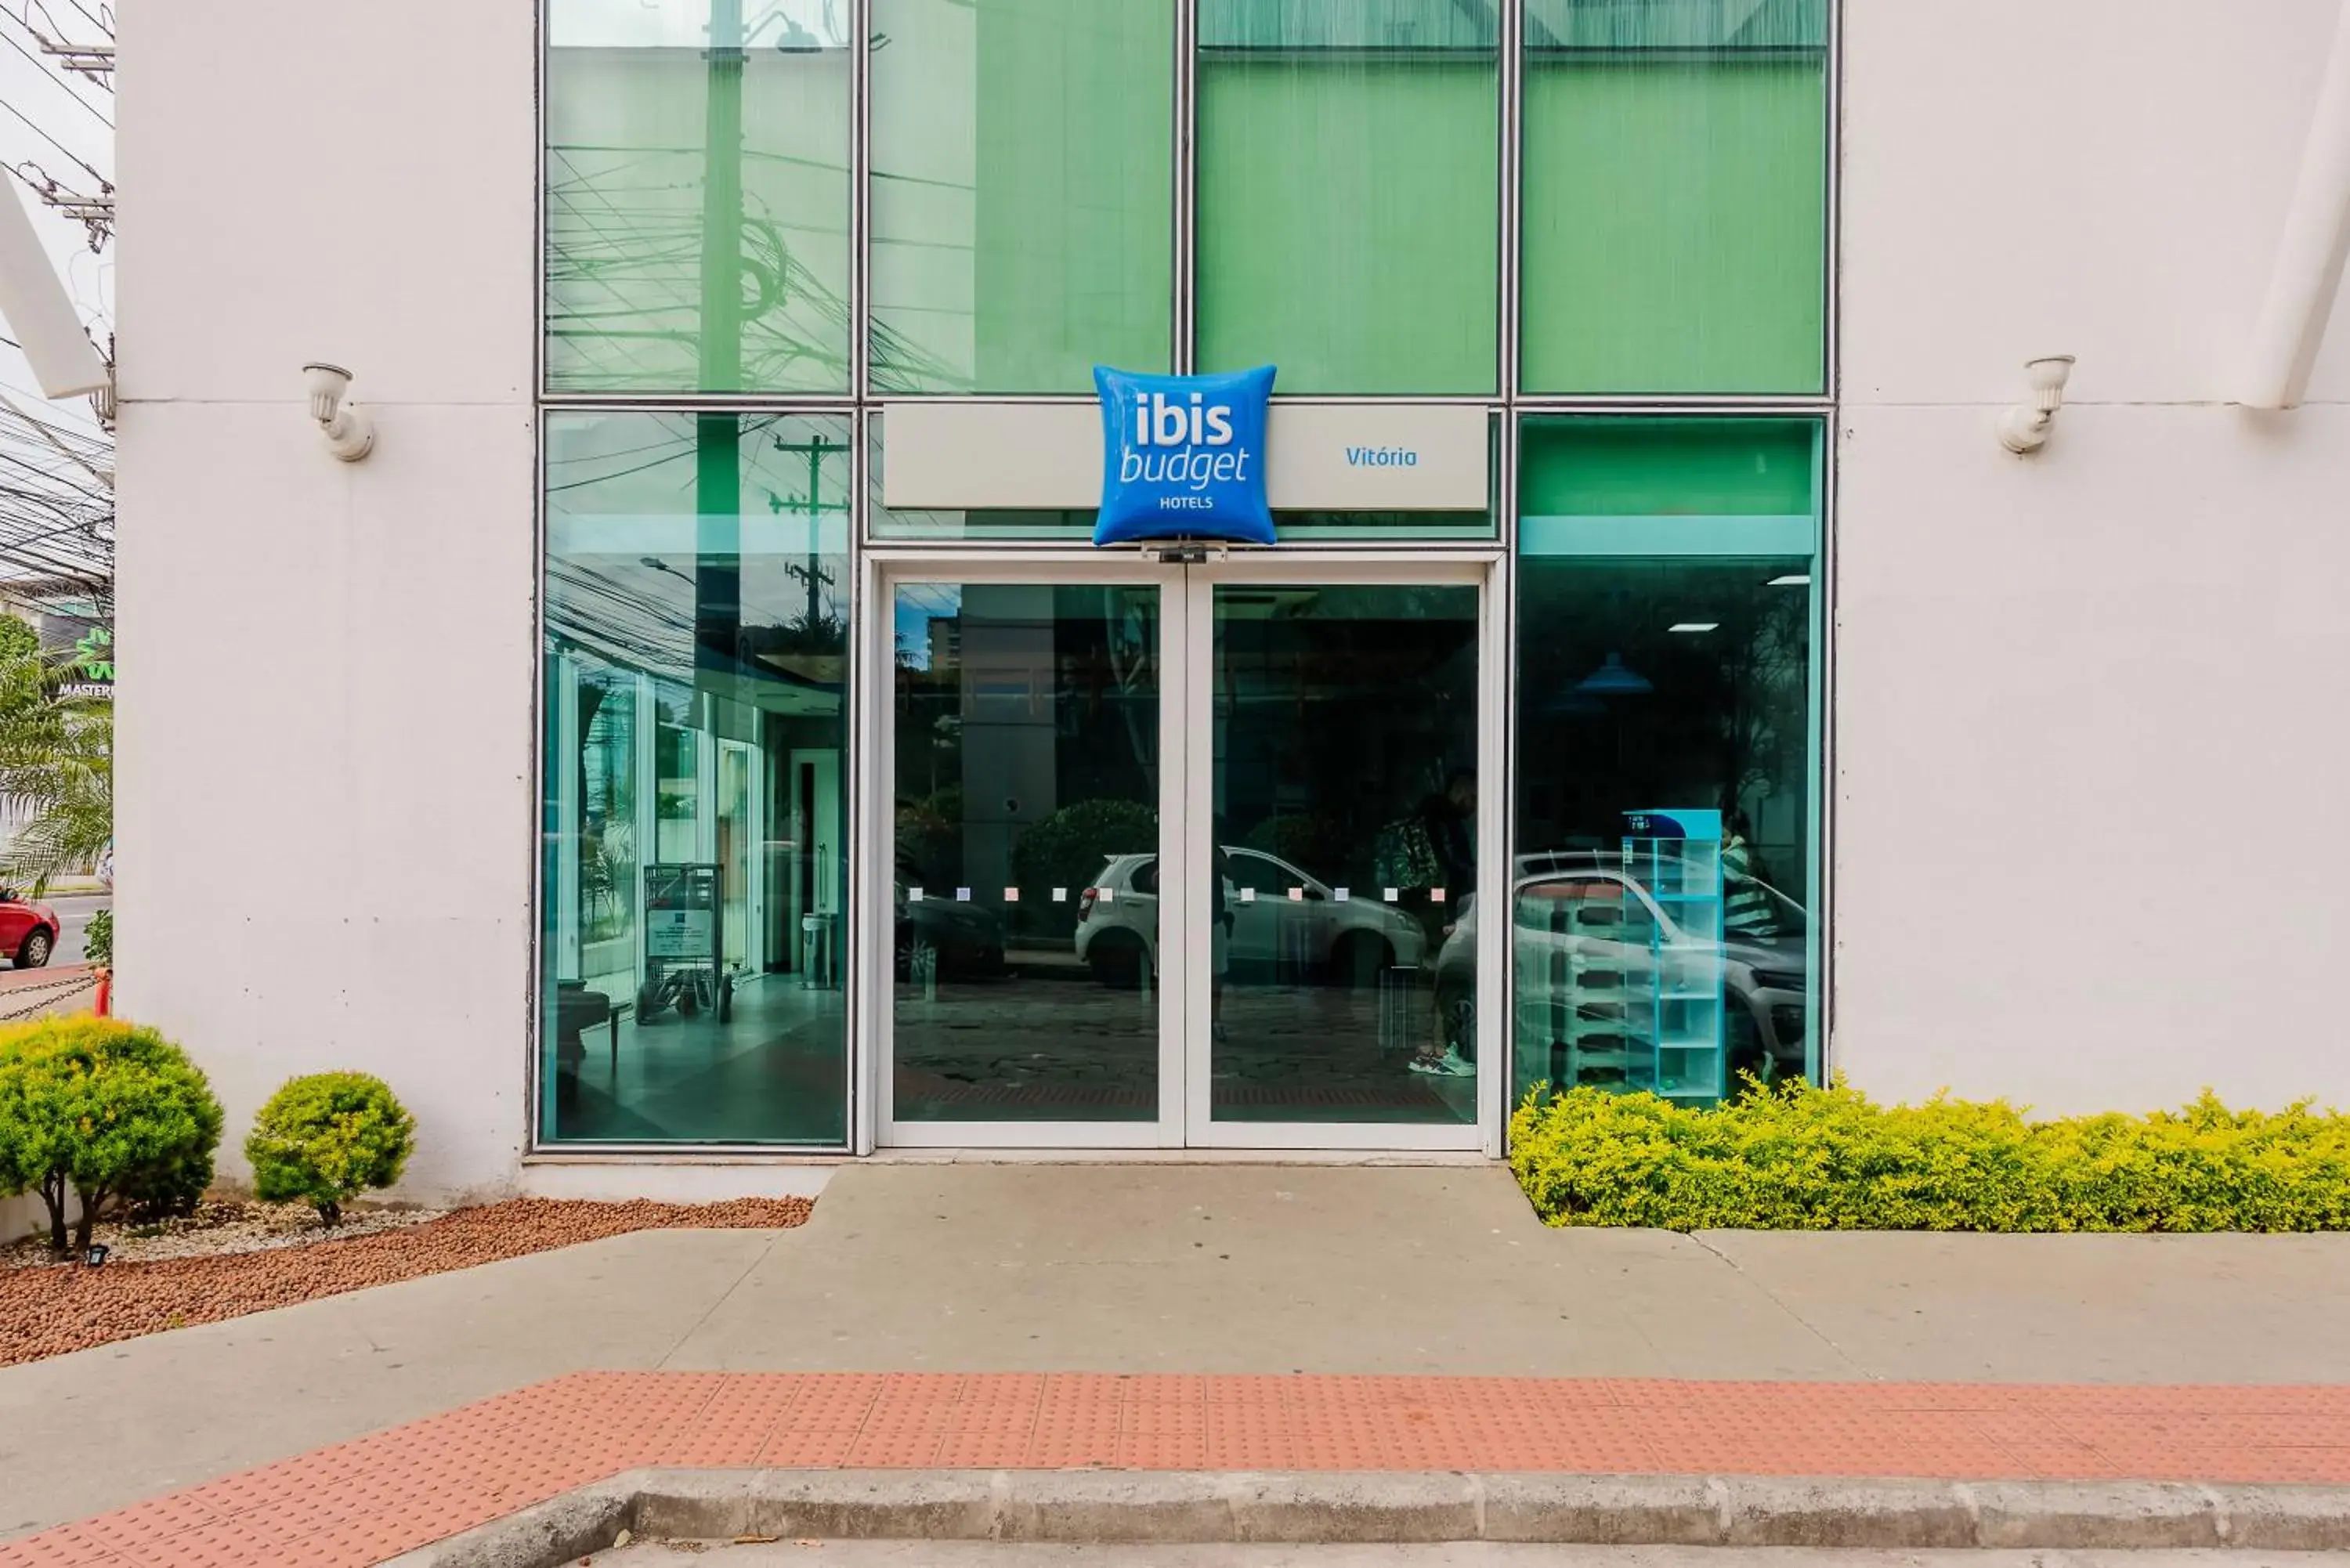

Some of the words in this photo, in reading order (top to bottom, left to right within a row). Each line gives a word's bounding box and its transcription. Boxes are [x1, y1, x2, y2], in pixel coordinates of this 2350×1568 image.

[1137, 392, 1233, 446] ibis
[1120, 445, 1249, 490] budget
[1347, 446, 1416, 466] Vitória
[1160, 497, 1213, 509] HOTELS
